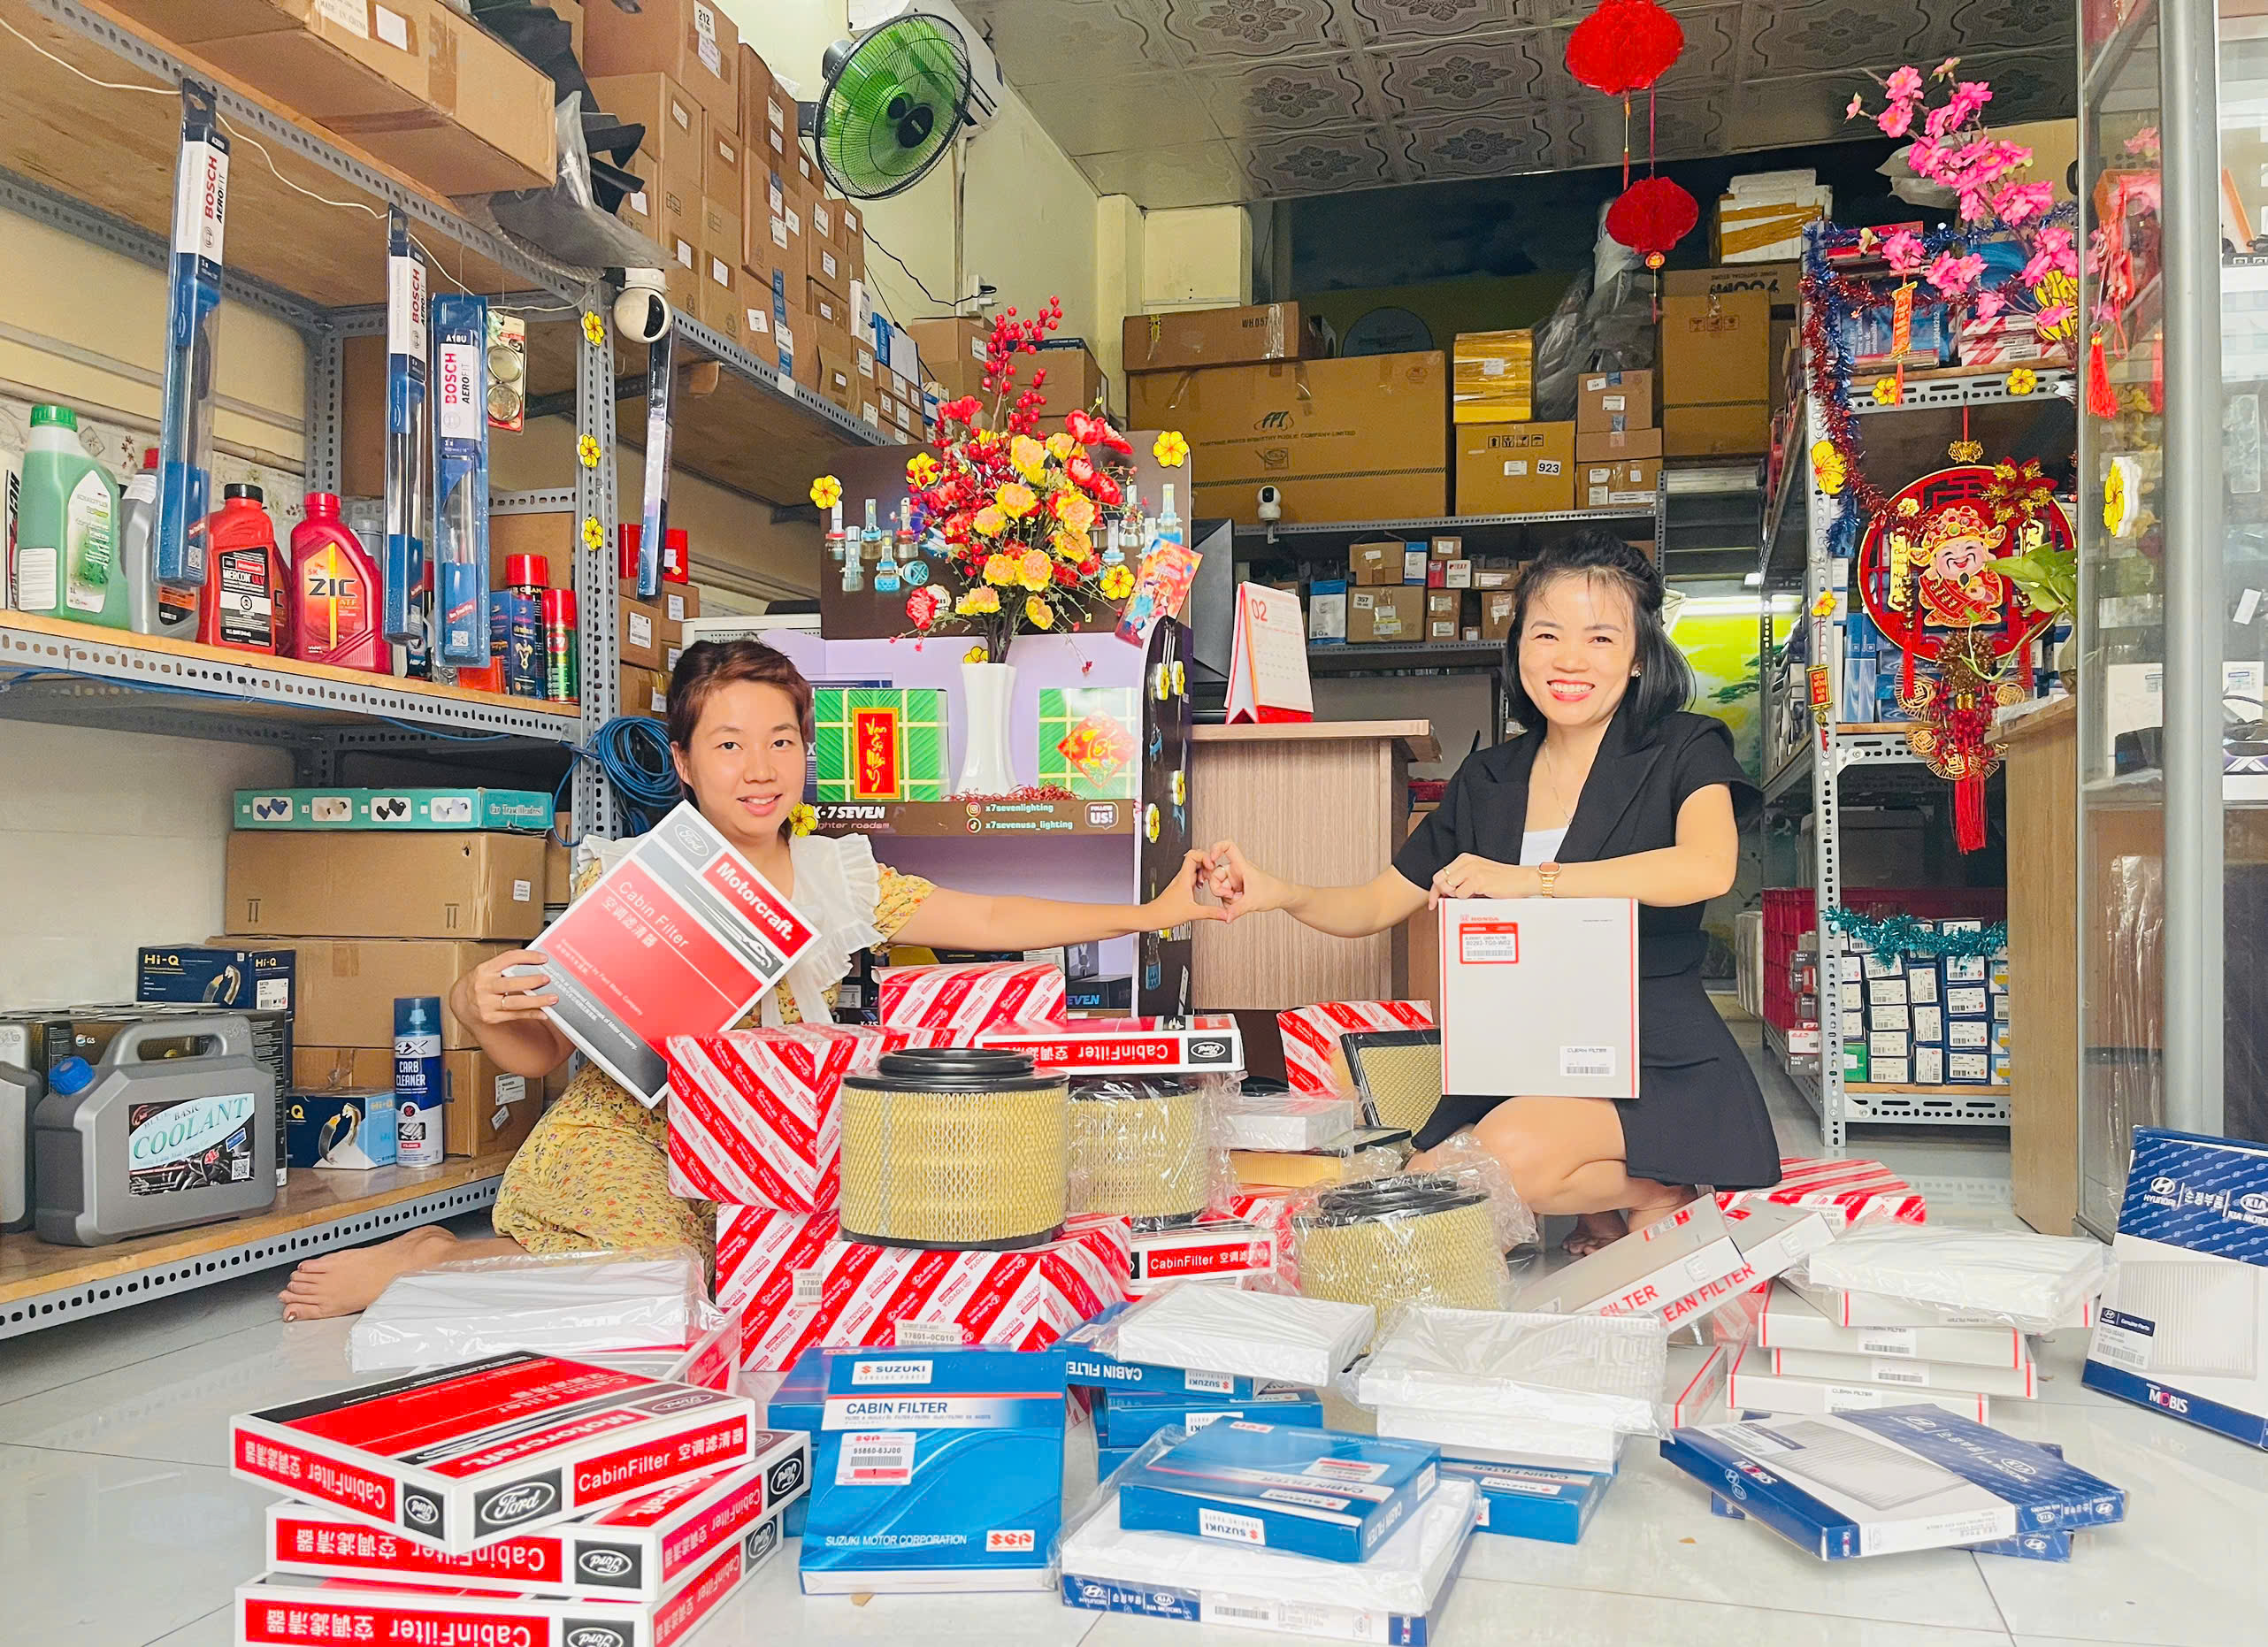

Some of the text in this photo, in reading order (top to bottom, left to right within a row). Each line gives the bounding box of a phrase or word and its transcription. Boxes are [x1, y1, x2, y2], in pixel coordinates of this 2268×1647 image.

[698, 9, 711, 27] 212
[204, 155, 218, 220] BOSCH
[216, 173, 226, 225] AEROFIT
[411, 268, 420, 325] BOSCH
[445, 334, 467, 344] A18U
[444, 353, 457, 405] BOSCH
[461, 362, 471, 405] AEROFIT
[1538, 463, 1560, 473] 923
[308, 578, 359, 598] ZIC
[1251, 598, 1268, 622] 02
[985, 803, 1054, 815] x7sevenlighting
[1089, 803, 1115, 813] FOLLOW
[1090, 811, 1115, 824] US!
[818, 822, 848, 831] ghter
[985, 819, 1074, 831] x7sevenusa_lighting
[678, 827, 705, 853] Ford
[715, 860, 794, 943] Motorcraft.
[601, 895, 659, 949] 空调滤清器
[618, 880, 690, 948] Cabin Filter
[143, 954, 180, 967] Hi-Q
[255, 958, 278, 968] Hi-Q
[1065, 994, 1102, 1006] EVEN
[395, 1039, 429, 1055] 4X
[1077, 1043, 1169, 1060] CabinFilter
[1197, 1044, 1222, 1056] Ford
[398, 1061, 420, 1074] CARB
[395, 1073, 426, 1087] CLEANER
[174, 1104, 201, 1122] BASIC
[134, 1096, 249, 1161] COOLANT
[2142, 1193, 2177, 1208] HYUNDAI
[2183, 1191, 2226, 1210] 순정부품
[2245, 1198, 2267, 1210] KIA
[2227, 1210, 2268, 1228] KIA MOTO
[770, 1221, 792, 1245] TOYOTA
[745, 1254, 767, 1279] TOYOTA
[920, 1255, 942, 1278] LEXUS
[1149, 1254, 1214, 1271] CabinFilter
[871, 1264, 895, 1289] TOYOTA
[722, 1288, 743, 1309] TOYOTA
[895, 1292, 916, 1314] LEXUS
[943, 1283, 966, 1307] TOYOTA
[1660, 1260, 1757, 1325] EAN FILTER
[847, 1300, 870, 1324] TOYOTA
[903, 1331, 955, 1343] 17801-0C010
[997, 1316, 1021, 1340] TOYOTA
[769, 1333, 791, 1354] TOYOTA
[875, 1364, 927, 1374] SUZUKI
[1067, 1360, 1143, 1382] CABIN FILTE
[1188, 1377, 1221, 1389] SUZUKI
[846, 1400, 949, 1415] CABIN FILTER
[2148, 1387, 2188, 1414] MOBIS
[460, 1410, 638, 1468] Motorcraft.
[577, 1426, 745, 1494] CabinFilter 空调滤清器
[2006, 1461, 2030, 1475] KIA
[244, 1440, 387, 1510] CabinFilter 空调滤清器
[777, 1462, 798, 1490] Ford
[1472, 1465, 1570, 1481] CABIN FILTER
[1731, 1459, 1779, 1485] MOBIS
[411, 1500, 434, 1521] Ford
[493, 1488, 542, 1521] Ford
[709, 1488, 762, 1533] CabinFilter
[1205, 1523, 1247, 1537] SUZUKI
[1366, 1501, 1403, 1548] CABIN FILTER
[295, 1528, 398, 1559] 空调滤清器
[753, 1525, 772, 1552] Ford
[824, 1534, 968, 1547] SUZUKI MOTOR CORPORATION
[989, 1532, 1033, 1546] SGP
[589, 1553, 623, 1574] Ford
[696, 1553, 741, 1604] CabinFilter
[267, 1609, 532, 1647] CabinFilter 空调滤清器
